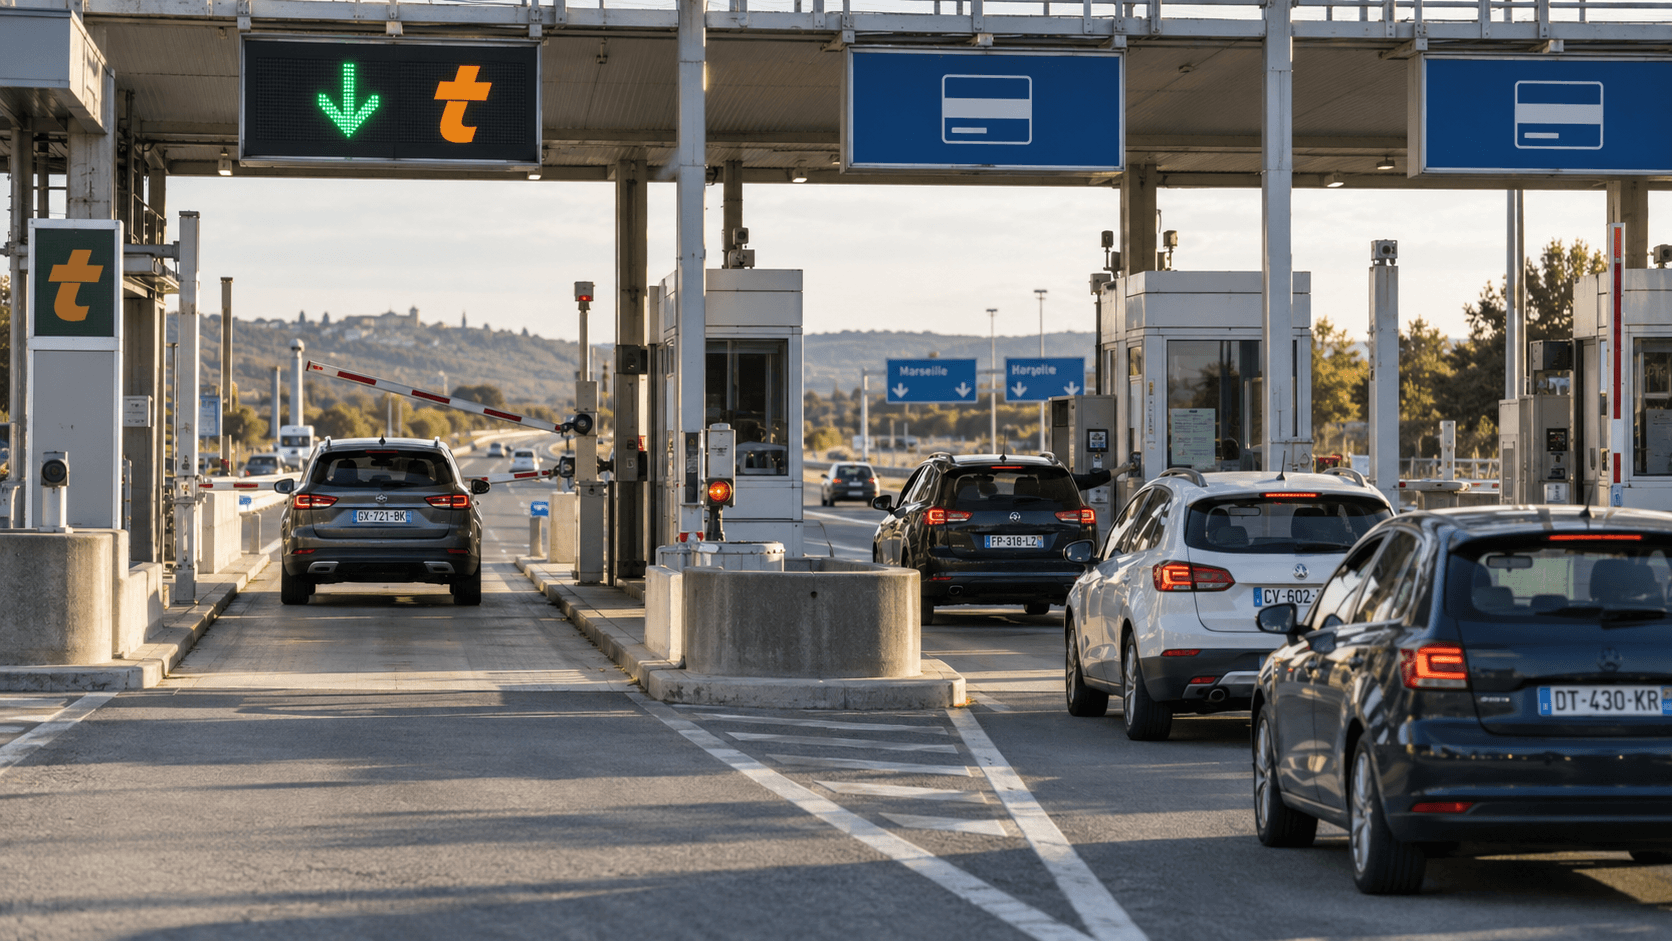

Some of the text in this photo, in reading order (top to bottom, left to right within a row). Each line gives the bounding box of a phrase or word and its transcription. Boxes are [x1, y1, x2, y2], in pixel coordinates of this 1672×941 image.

[434, 65, 492, 143] t
[48, 249, 104, 322] t
[358, 511, 406, 521] GX-721-BK
[1264, 589, 1320, 604] CV-602-
[1555, 689, 1660, 711] DT-430-KR
